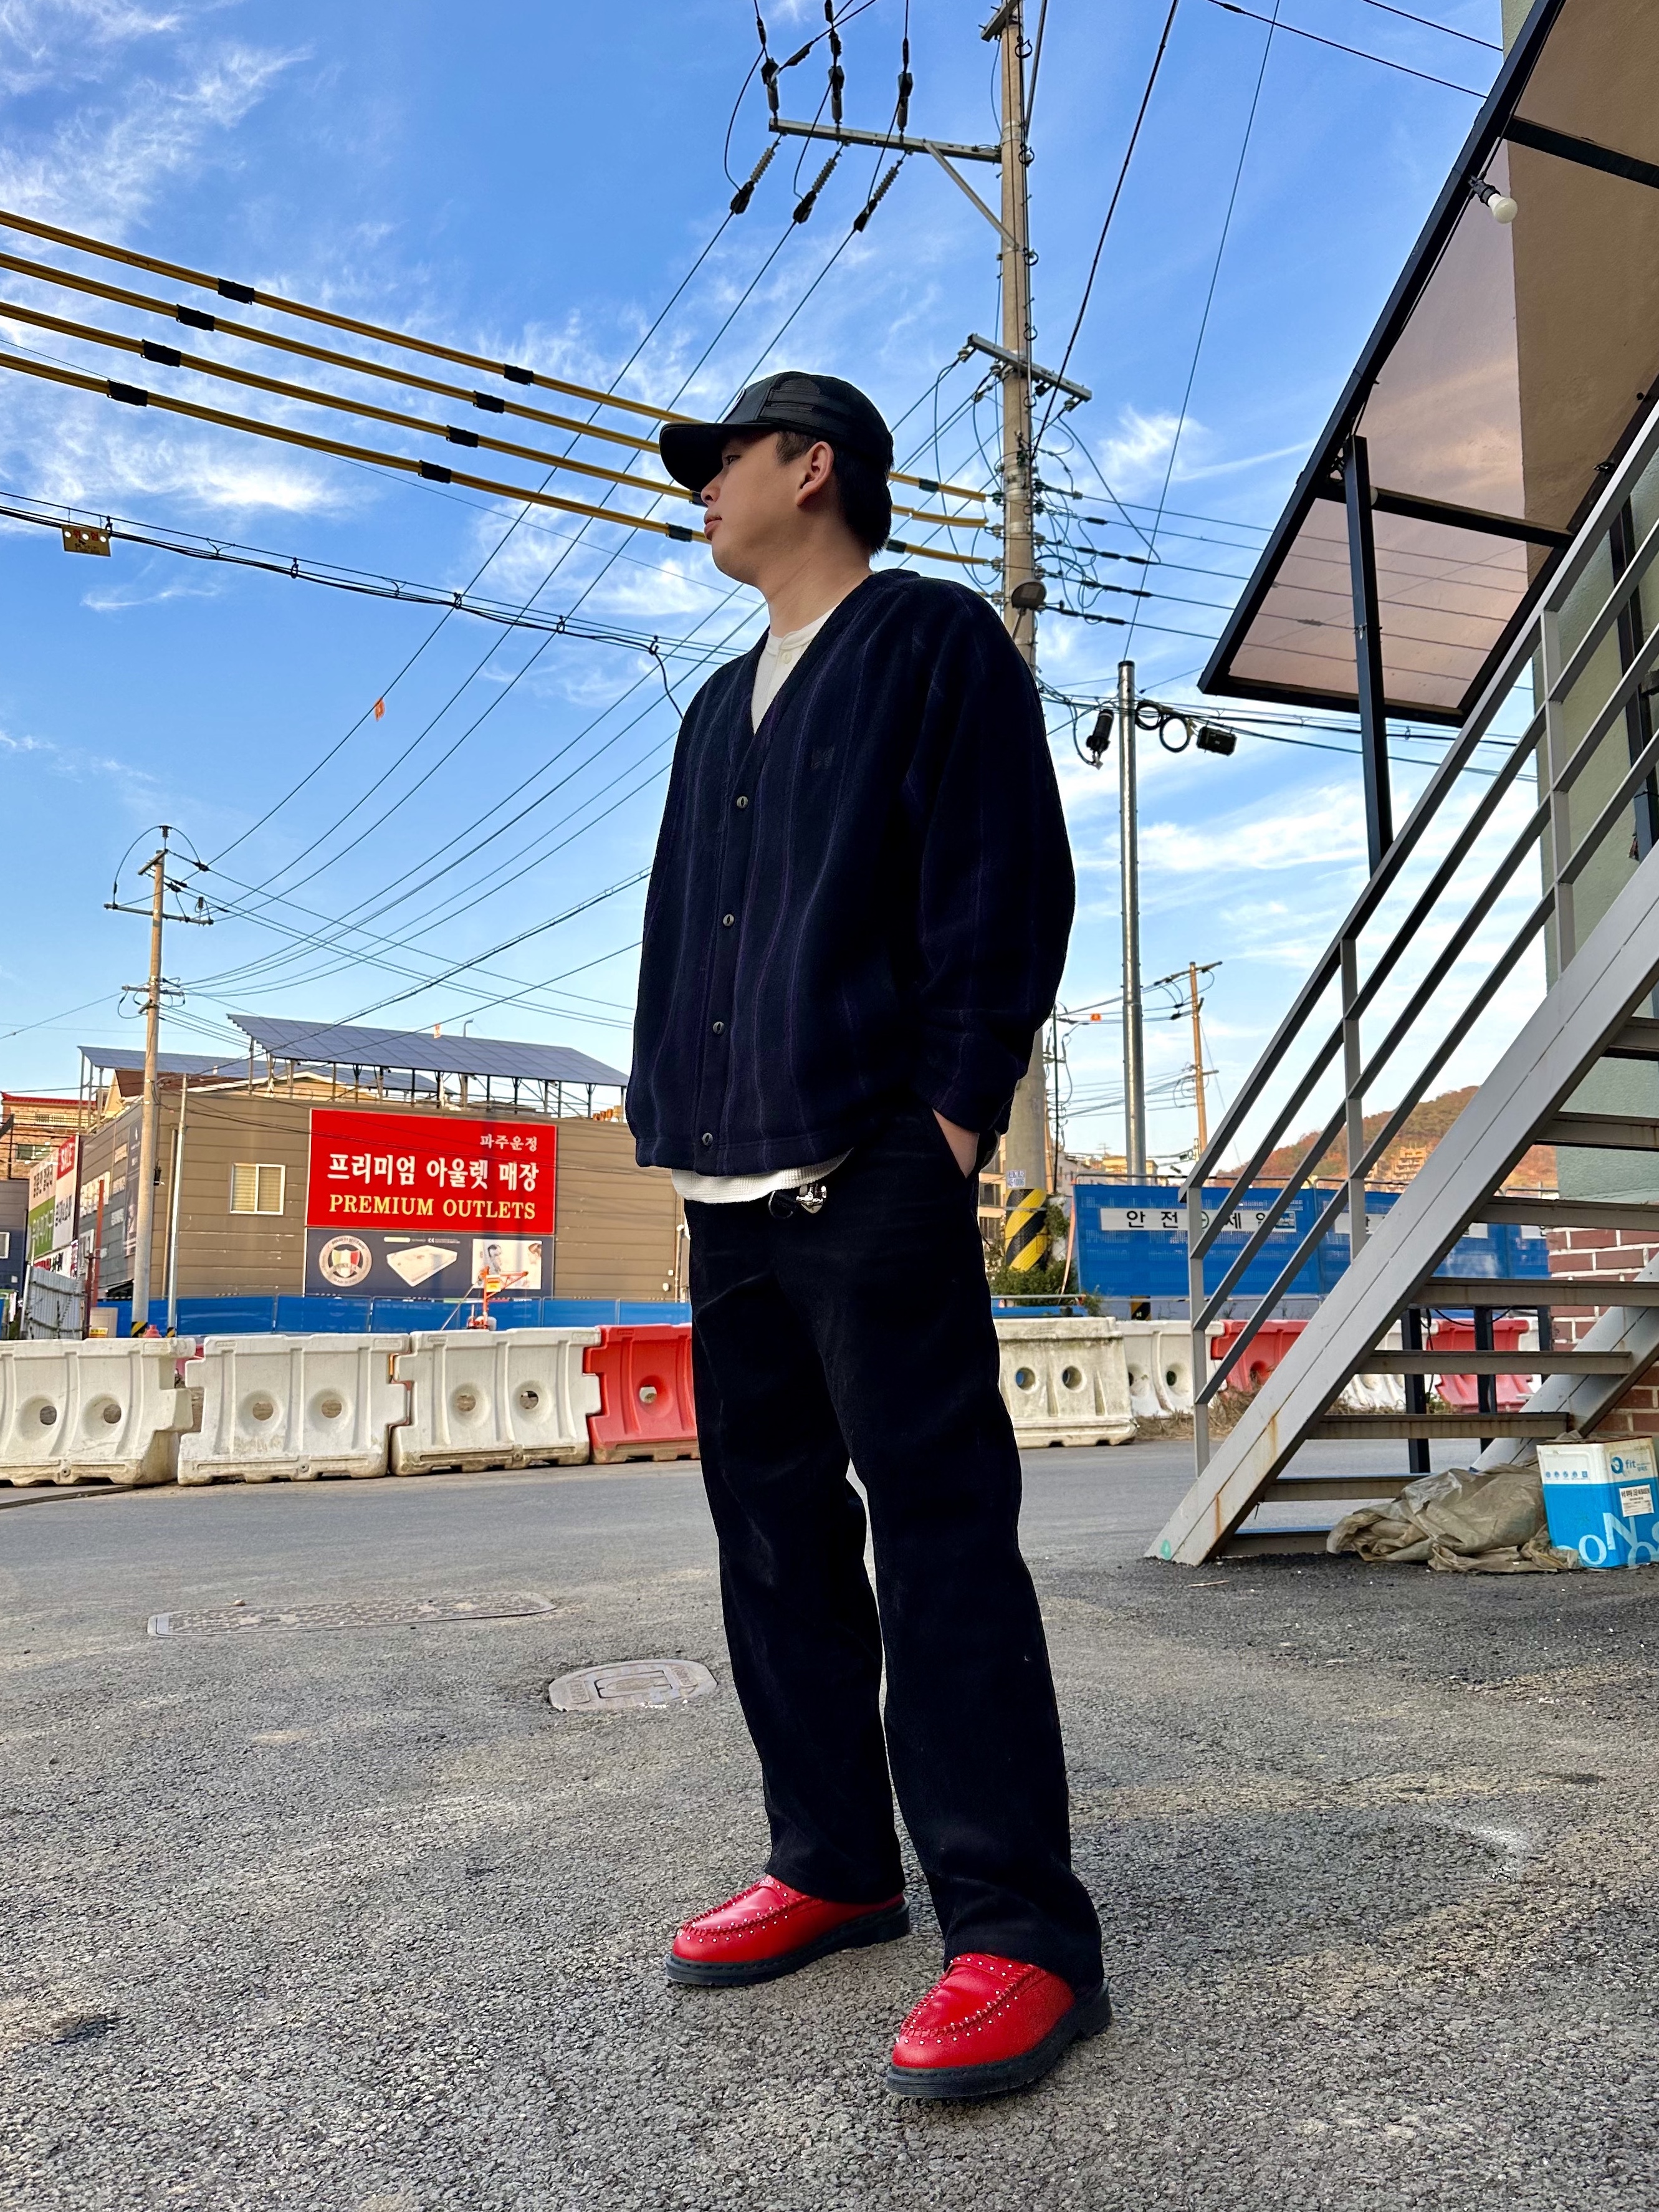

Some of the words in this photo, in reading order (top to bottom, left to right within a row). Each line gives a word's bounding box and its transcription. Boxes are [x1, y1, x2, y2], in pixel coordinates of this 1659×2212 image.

[480, 1133, 537, 1152] 파주운정
[327, 1153, 416, 1186] 프리미엄
[426, 1157, 488, 1190] 아울렛
[499, 1162, 540, 1192] 매장
[329, 1194, 434, 1216] PREMIUM
[442, 1199, 536, 1220] OUTLETS
